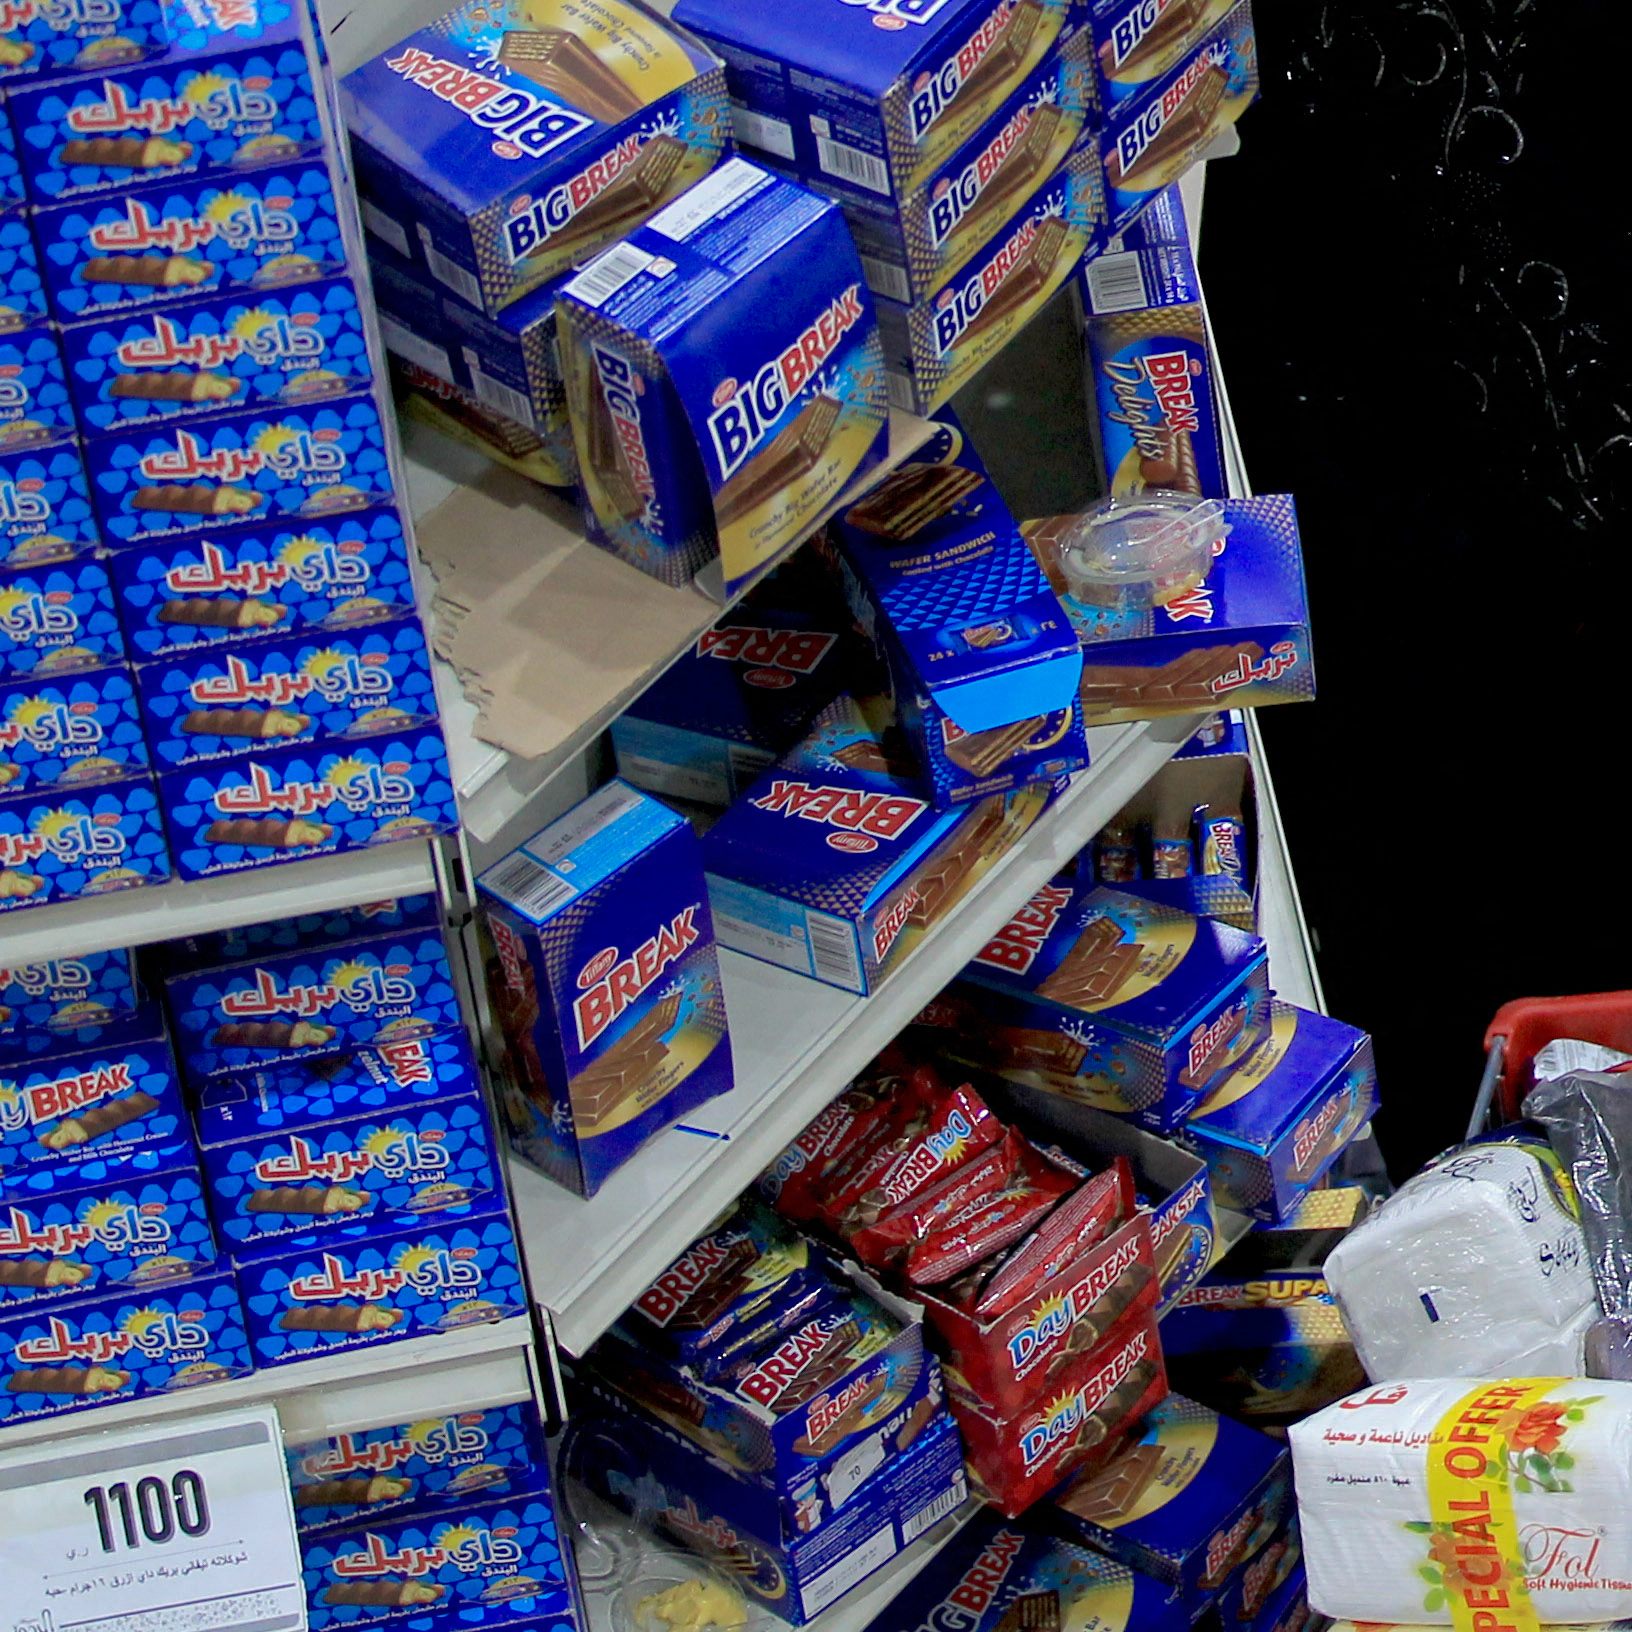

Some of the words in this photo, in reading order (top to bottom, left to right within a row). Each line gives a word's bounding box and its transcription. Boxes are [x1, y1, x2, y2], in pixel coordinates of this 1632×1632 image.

[67, 78, 195, 135] بريك
[195, 79, 279, 131] داي
[384, 47, 506, 114] BREAK
[909, 66, 965, 144] BIG
[471, 88, 596, 159] BIG
[1117, 103, 1164, 176] BIG
[1160, 47, 1212, 120] BREAK
[502, 188, 572, 266] BIG
[568, 132, 643, 213] BREAK
[928, 171, 982, 250] BIG
[975, 99, 1033, 190] BREAK
[89, 197, 216, 253] بريك
[214, 199, 299, 249] داي
[932, 281, 985, 358] BIG
[979, 214, 1038, 298] BREAK
[117, 313, 243, 368] بريك
[242, 315, 325, 365] داي
[590, 341, 643, 423] BIG
[707, 358, 789, 482] BIG
[777, 284, 865, 400] BREAK
[1103, 356, 1166, 461] Delights
[1141, 349, 1200, 434] BREAK
[140, 428, 264, 482] بريك
[262, 430, 347, 478] داي
[614, 413, 655, 495] BREAK
[165, 540, 290, 595] بريك
[287, 543, 370, 594] داي
[888, 550, 933, 570] WAFER
[934, 531, 997, 561] SANDWICH
[190, 654, 313, 706] بريك
[311, 655, 392, 703] داي
[1211, 651, 1298, 694] بريك
[22, 704, 103, 751] داي
[213, 762, 337, 814] بريك
[333, 765, 414, 810] داي
[755, 779, 931, 841] BREAK
[826, 831, 879, 854] Tiffany
[874, 885, 921, 964] BREAK
[974, 881, 1074, 976] BREAK
[221, 967, 339, 1017] بريك
[338, 969, 416, 1012] داي
[573, 905, 700, 1054] BREAK
[576, 947, 619, 989] Tiffany
[1188, 1008, 1235, 1078] BREAK
[29, 1063, 134, 1126] BREAK
[255, 1135, 371, 1184] بريك
[370, 1131, 450, 1183] داي
[928, 1109, 973, 1162] Day
[1291, 1098, 1340, 1172] BREAK
[887, 1145, 940, 1204] BREAK
[289, 1252, 406, 1302] بريك
[403, 1246, 483, 1291] داي
[636, 1236, 731, 1330] BREAK
[1009, 1294, 1075, 1370] Day
[1069, 1232, 1142, 1321] BREAK
[1177, 1286, 1245, 1308] BREAK
[15, 1316, 129, 1364] بريك
[128, 1306, 210, 1352] داي
[736, 1321, 832, 1411] BREAK
[1014, 1340, 1059, 1384] Chocolate
[805, 1371, 870, 1445] BREAK
[1020, 1399, 1085, 1466] Day
[1080, 1329, 1148, 1419] BREAK
[1026, 1434, 1070, 1479] Chocolate
[1322, 1428, 1357, 1444] صحية
[1357, 1432, 1367, 1446] و
[1369, 1428, 1403, 1447] ناعمة
[1443, 1385, 1535, 1480] OFFER
[847, 1465, 862, 1481] 70
[84, 1469, 212, 1553] 1100
[332, 1532, 449, 1577] بريك
[448, 1530, 522, 1574] داي
[949, 1528, 1026, 1616] BREAK
[1449, 1491, 1519, 1632] PECIAL
[1519, 1523, 1601, 1582] Fol
